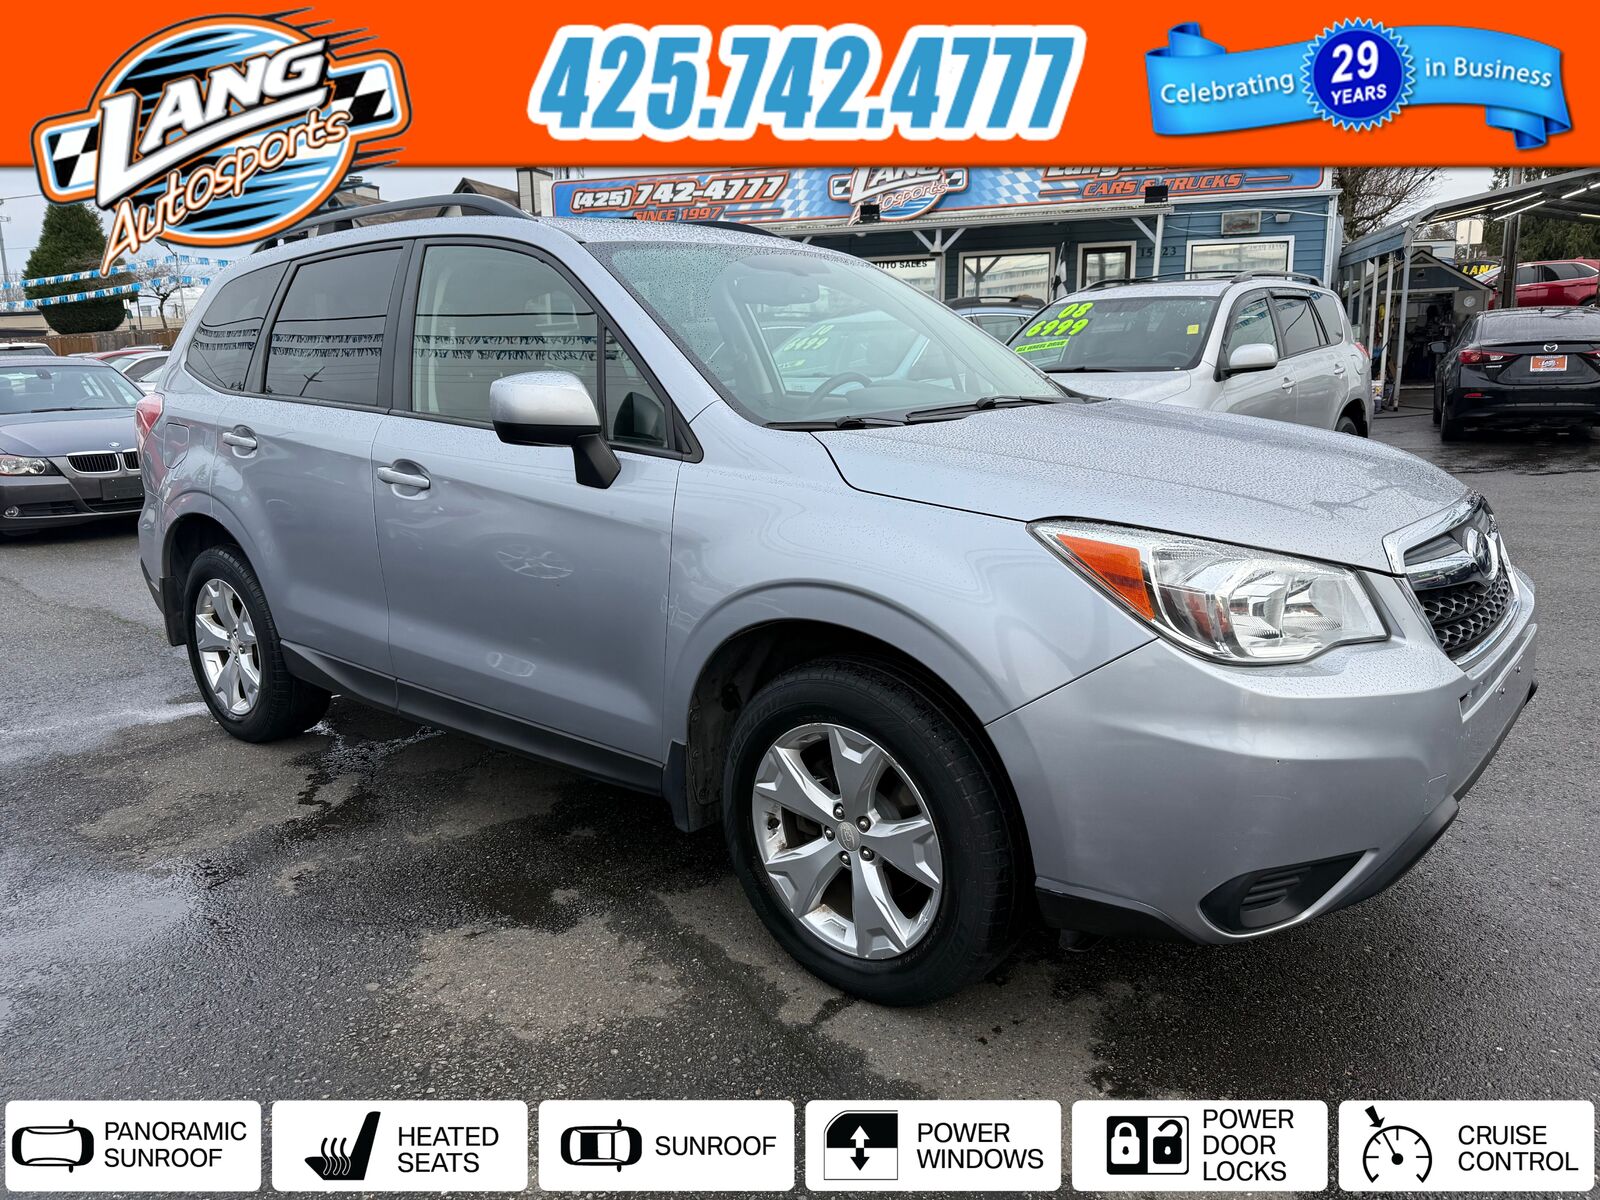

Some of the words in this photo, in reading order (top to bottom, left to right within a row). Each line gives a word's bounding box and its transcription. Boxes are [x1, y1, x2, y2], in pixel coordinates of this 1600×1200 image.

[573, 189, 632, 209] (425)
[633, 175, 785, 205] 742-4777
[1084, 180, 1136, 197] CARS
[1163, 173, 1244, 191] TRUCKS
[635, 208, 677, 221] SINCE
[680, 206, 723, 220] 1997
[848, 181, 949, 227] Atosports
[877, 261, 897, 269] UTO
[899, 260, 928, 269] SALES
[1058, 302, 1094, 319] 08
[1026, 318, 1090, 337] 6999
